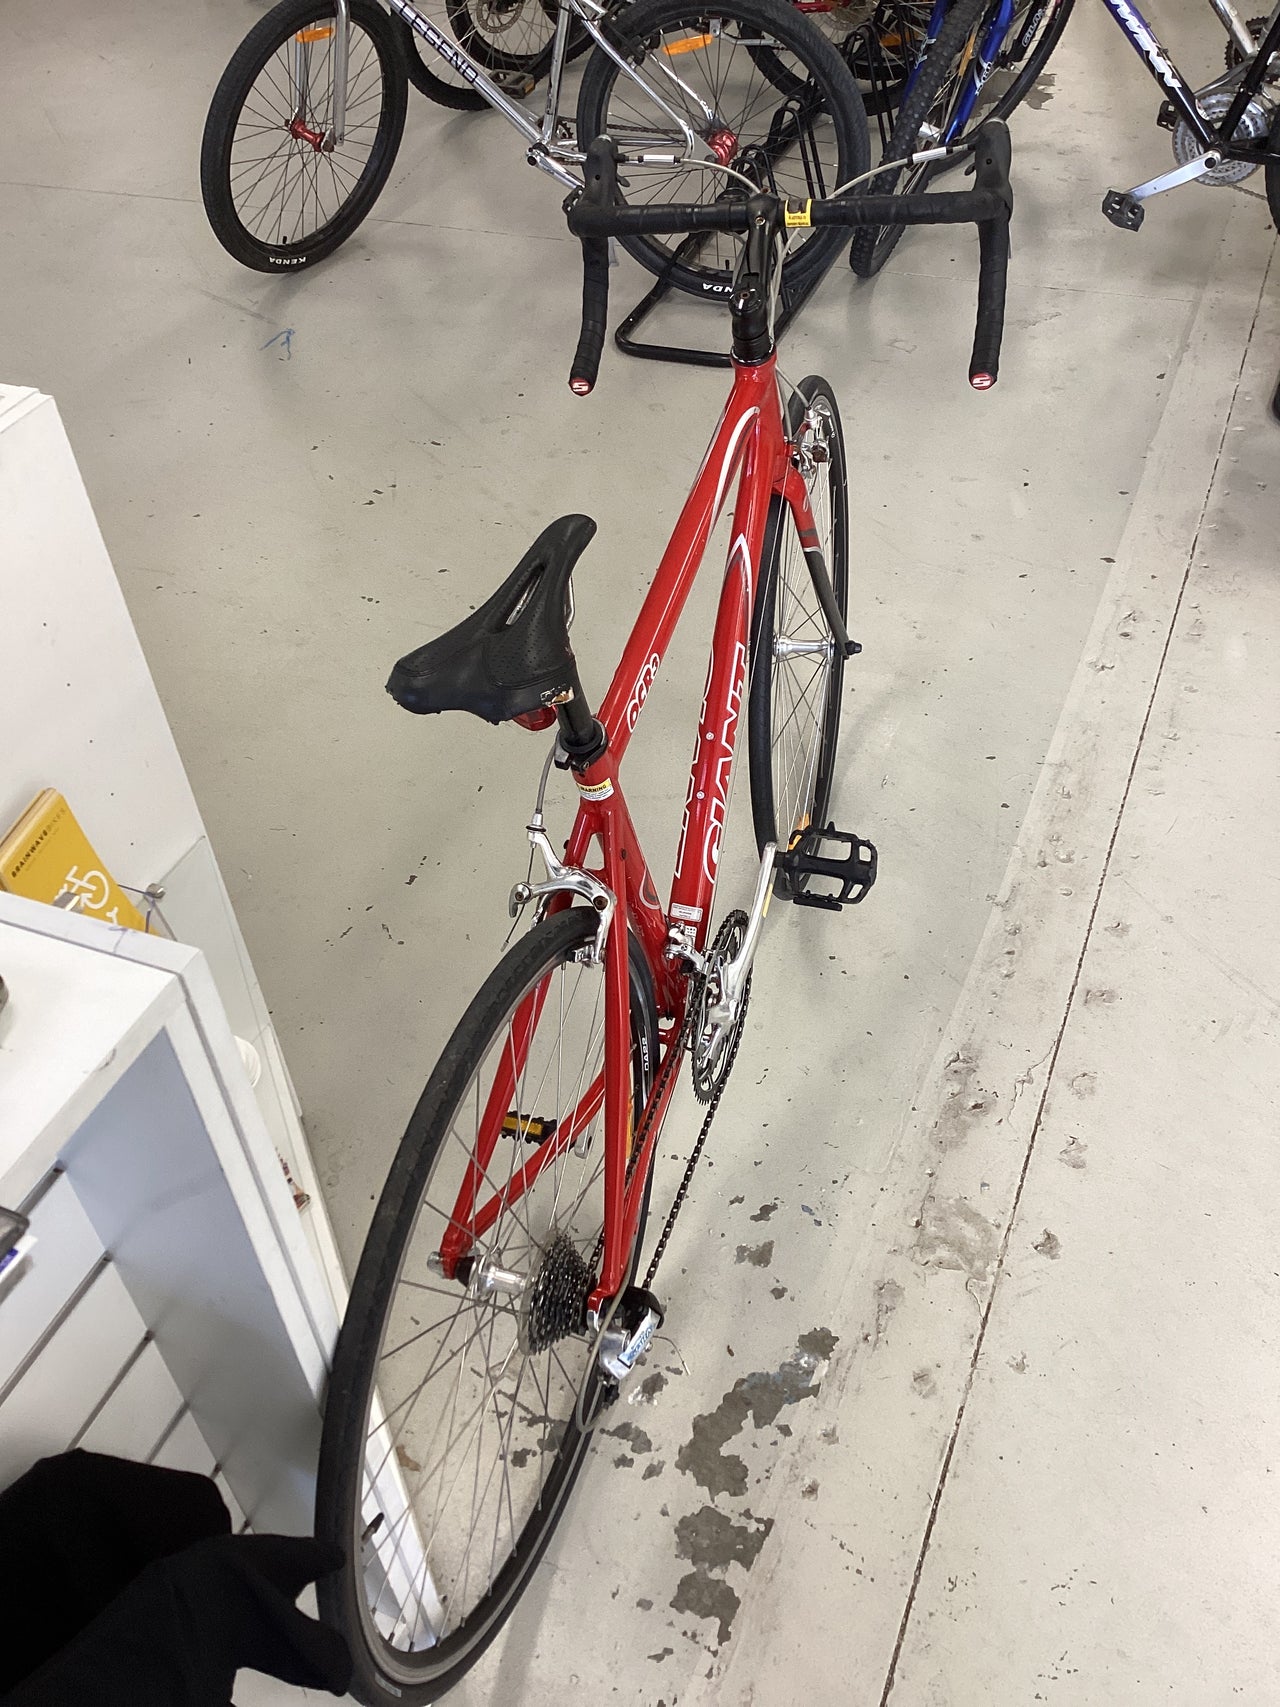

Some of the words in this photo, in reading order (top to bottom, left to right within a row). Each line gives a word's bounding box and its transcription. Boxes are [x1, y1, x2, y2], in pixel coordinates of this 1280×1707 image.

[400, 2, 479, 84] LEGEND
[269, 256, 306, 265] KENDA
[702, 283, 733, 293] NDA
[703, 642, 746, 884] GIANT
[580, 784, 607, 793] WARNING
